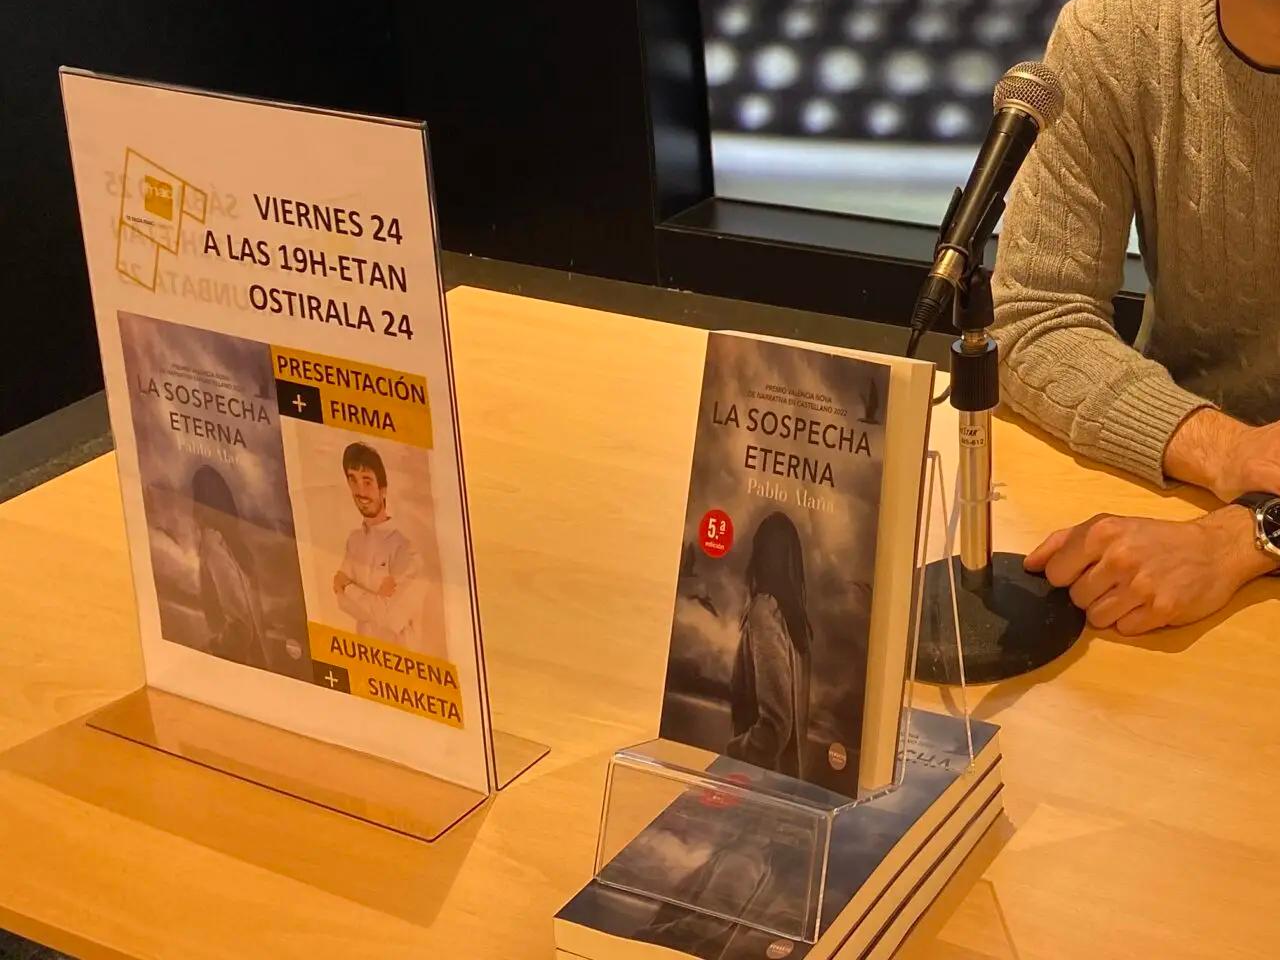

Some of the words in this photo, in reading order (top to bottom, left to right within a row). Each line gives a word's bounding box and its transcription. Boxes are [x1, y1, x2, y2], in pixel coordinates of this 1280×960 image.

[253, 193, 364, 238] VIERNES
[370, 214, 403, 245] 24
[203, 230, 221, 257] A
[226, 234, 271, 267] LAS
[278, 244, 408, 293] 19H-ETAN
[249, 284, 375, 333] OSTIRALA
[381, 310, 414, 341] 24
[137, 374, 160, 398] LA
[163, 381, 271, 425] SOSPECHA
[276, 355, 426, 405] PRESENTACIÓN
[169, 411, 247, 449] ETERNA
[330, 400, 396, 432] FIRMA
[712, 401, 740, 428] LA
[746, 408, 871, 457] SOSPECHA
[744, 445, 835, 488] ETERNA
[747, 478, 788, 502] Pablo
[330, 636, 458, 689] AURKEZPENA
[367, 677, 462, 723] SINAKETA
